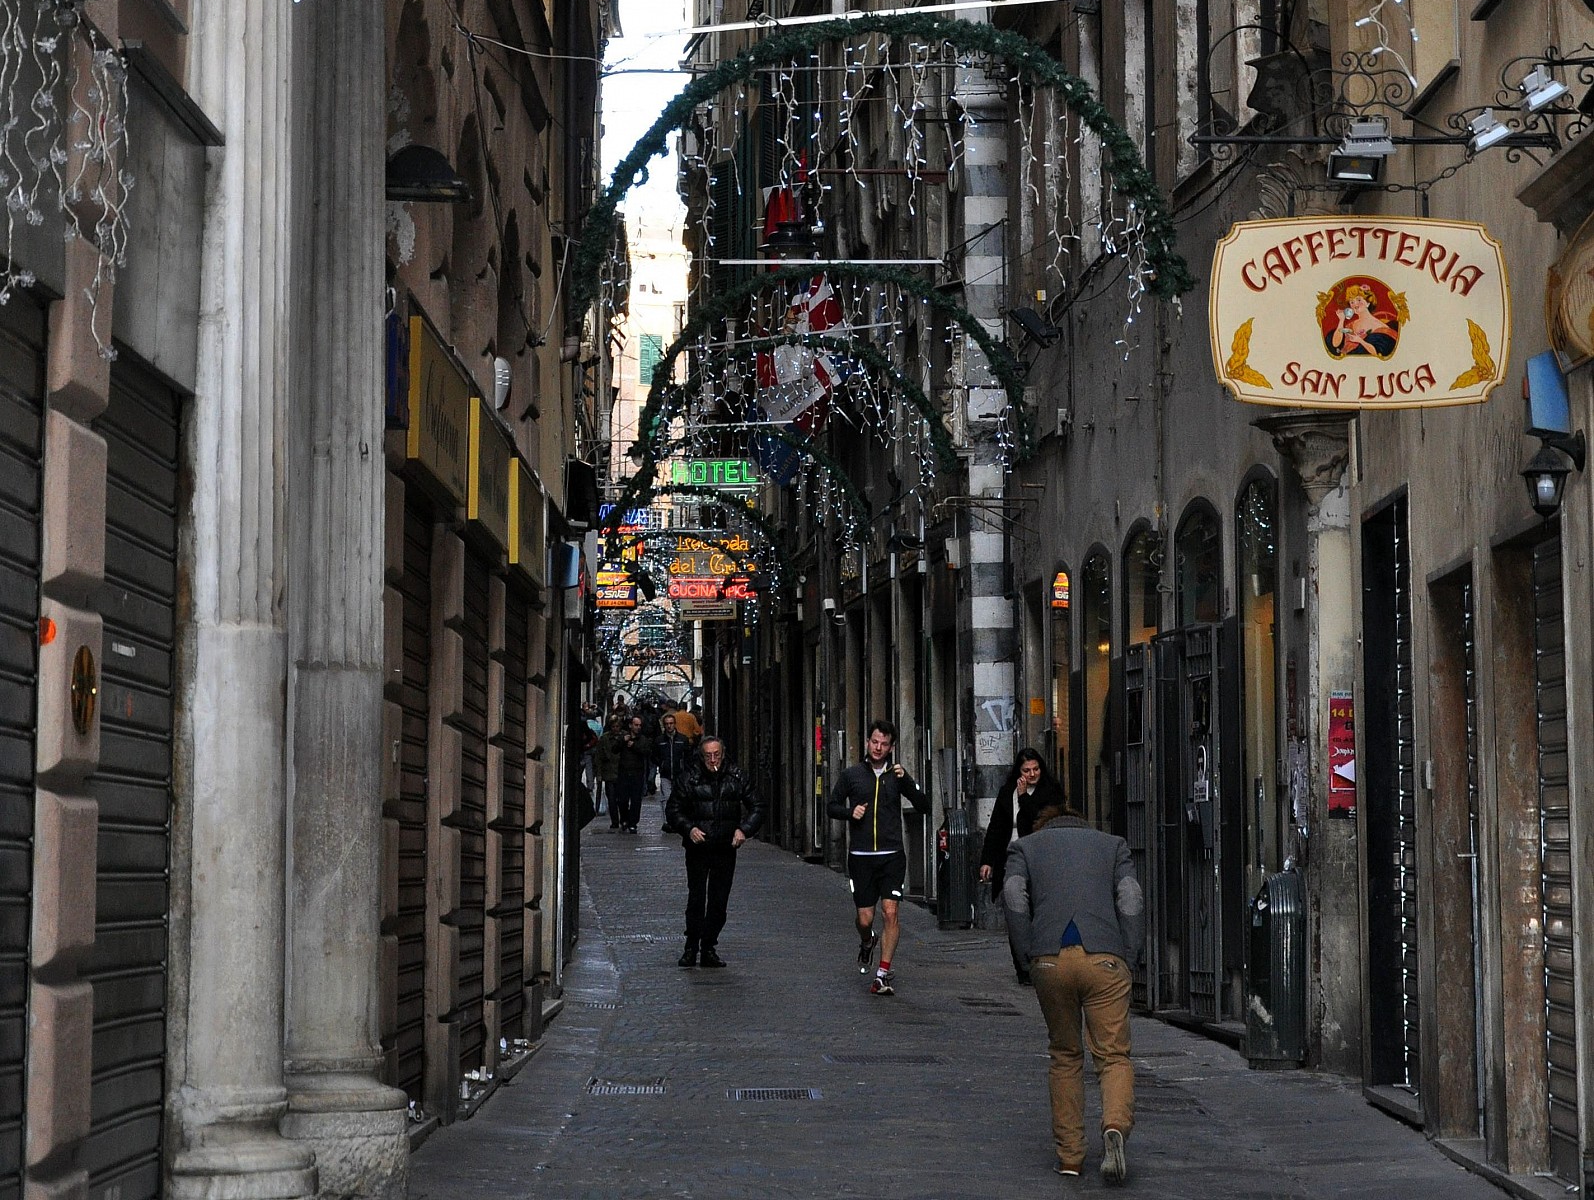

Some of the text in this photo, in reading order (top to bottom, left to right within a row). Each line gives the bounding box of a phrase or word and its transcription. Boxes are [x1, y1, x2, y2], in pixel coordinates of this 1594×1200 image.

[1241, 226, 1486, 297] CAFFETTERIA
[1280, 361, 1437, 400] SAN LUCA
[672, 460, 758, 485] HOTEL
[669, 584, 718, 598] CUCINA
[1331, 708, 1346, 718] 14
